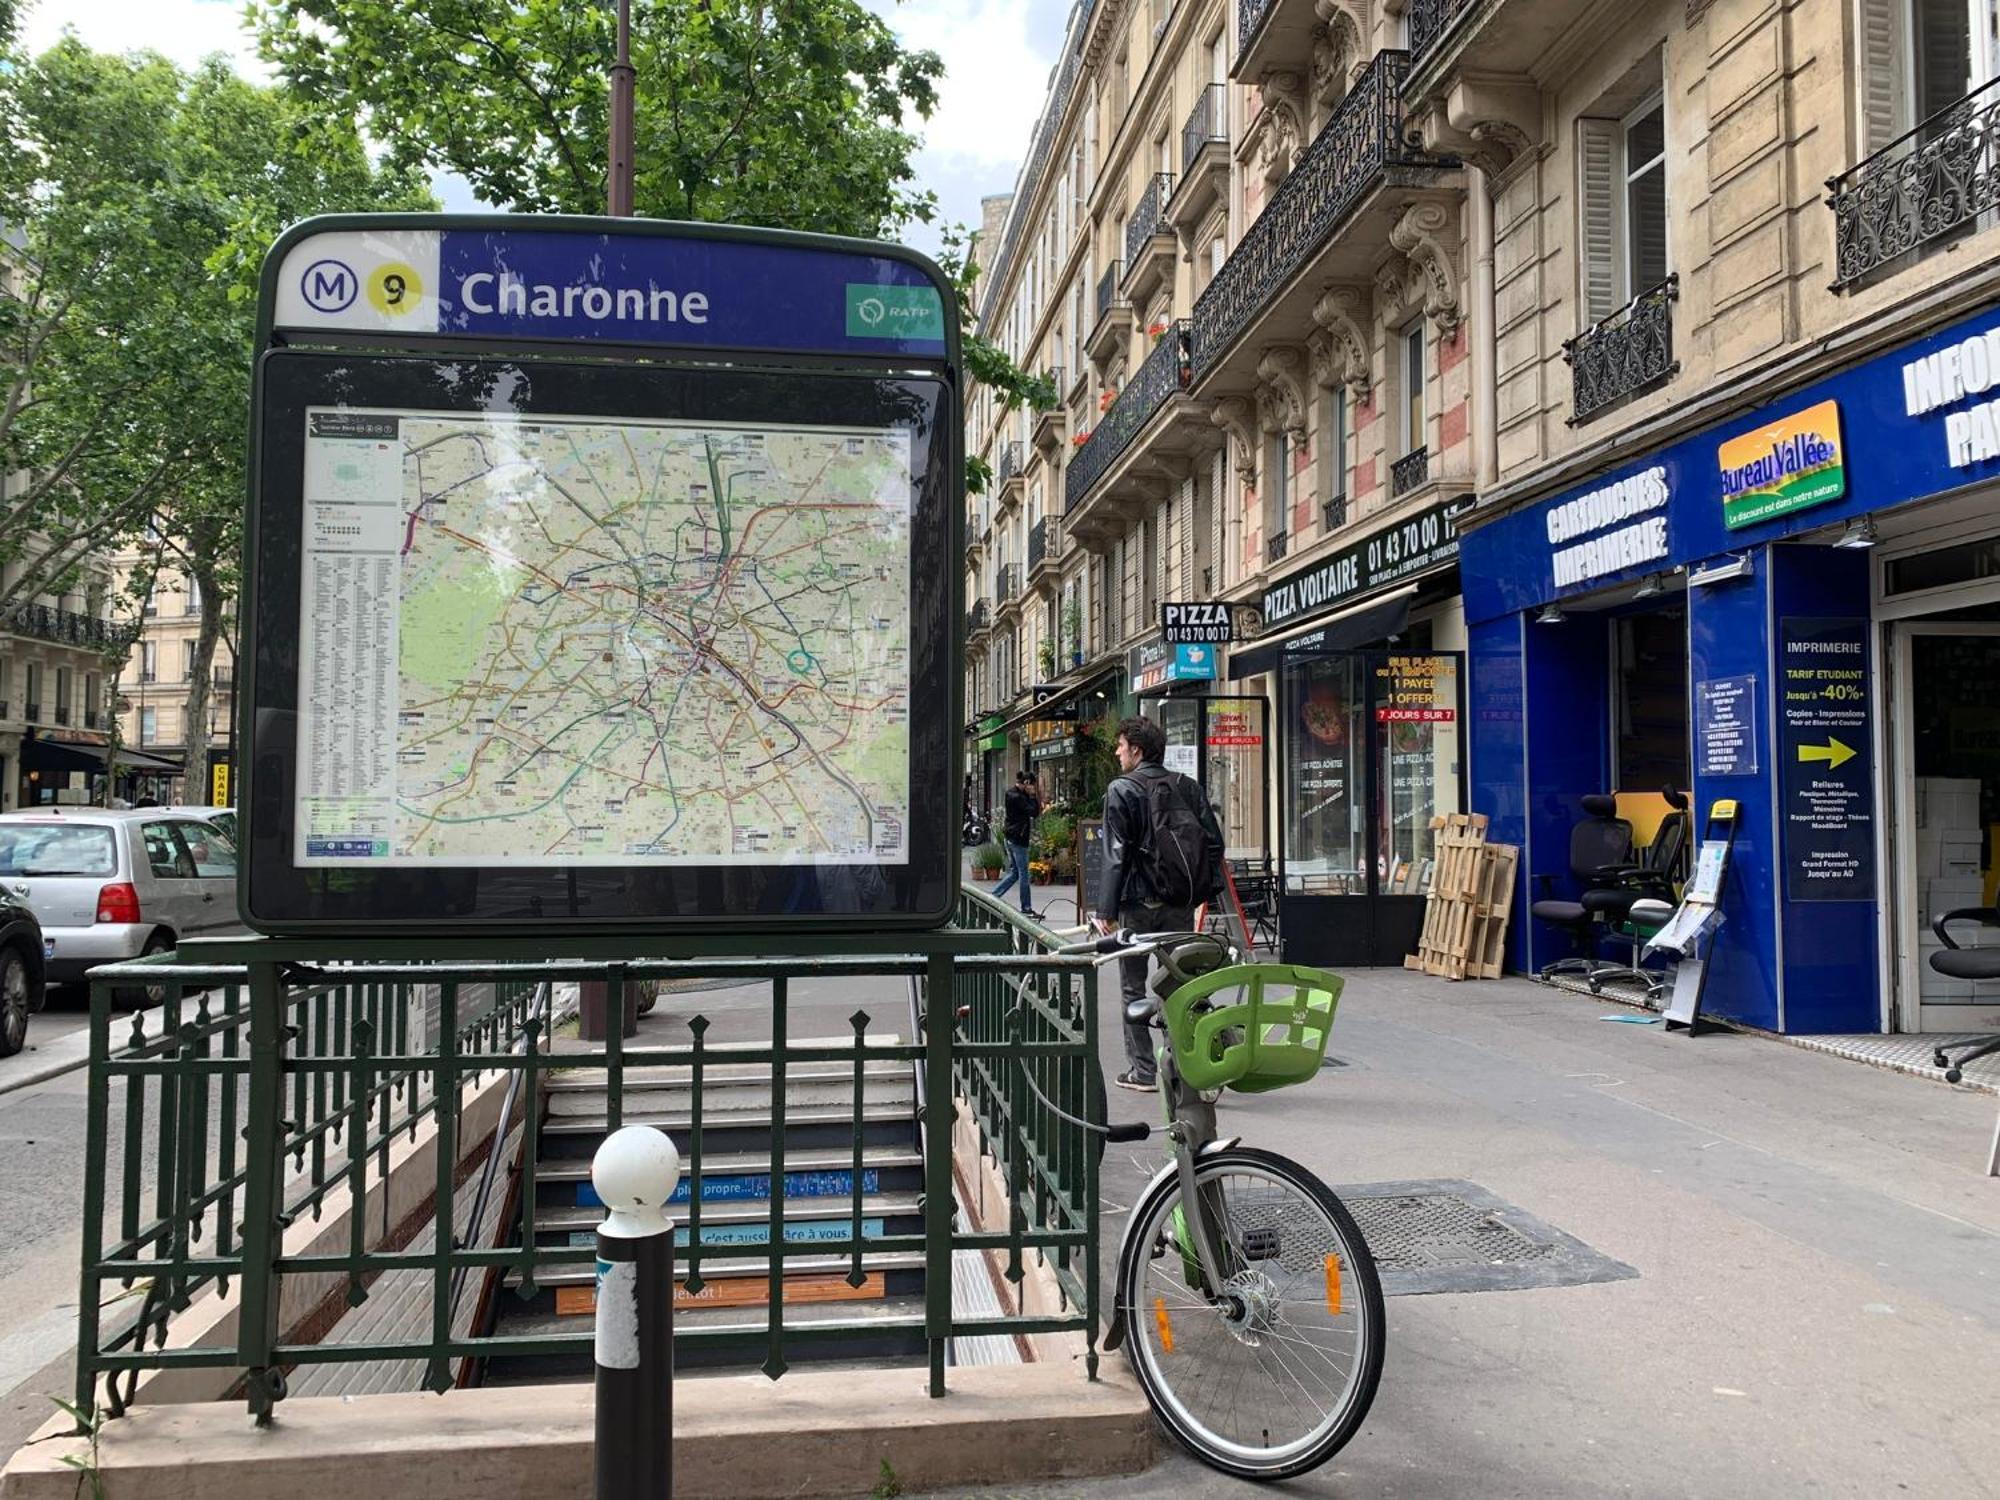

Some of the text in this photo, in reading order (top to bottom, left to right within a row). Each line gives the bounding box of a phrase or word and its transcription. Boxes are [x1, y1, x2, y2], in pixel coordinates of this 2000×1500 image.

[315, 271, 406, 305] M 9
[461, 272, 709, 324] Charonne
[889, 307, 929, 317] RATP
[1720, 455, 1773, 495] Bureau
[1546, 466, 1669, 544] CARTOUCHES
[1738, 507, 1764, 521] discount
[1765, 502, 1775, 512] est
[1776, 498, 1792, 509] dans
[1793, 491, 1812, 503] notre
[1814, 483, 1839, 497] nature
[1552, 516, 1669, 588] IMPRIMERIE
[1264, 583, 1297, 624] PIZZA
[1299, 554, 1359, 610] VOLTAIRE
[1368, 540, 1381, 572] 01
[1386, 531, 1400, 564] 43
[1403, 522, 1418, 557] 70
[1421, 513, 1438, 549] 00
[1166, 605, 1229, 625] PIZZA
[1167, 627, 1229, 641] 01 43 70 00 17
[1787, 641, 1862, 653] IMPRIMERIE
[1786, 670, 1863, 679] TARIF ETUDIANT
[1379, 710, 1452, 719] 7 JOURS SUR 7
[703, 1184, 751, 1197] propre...
